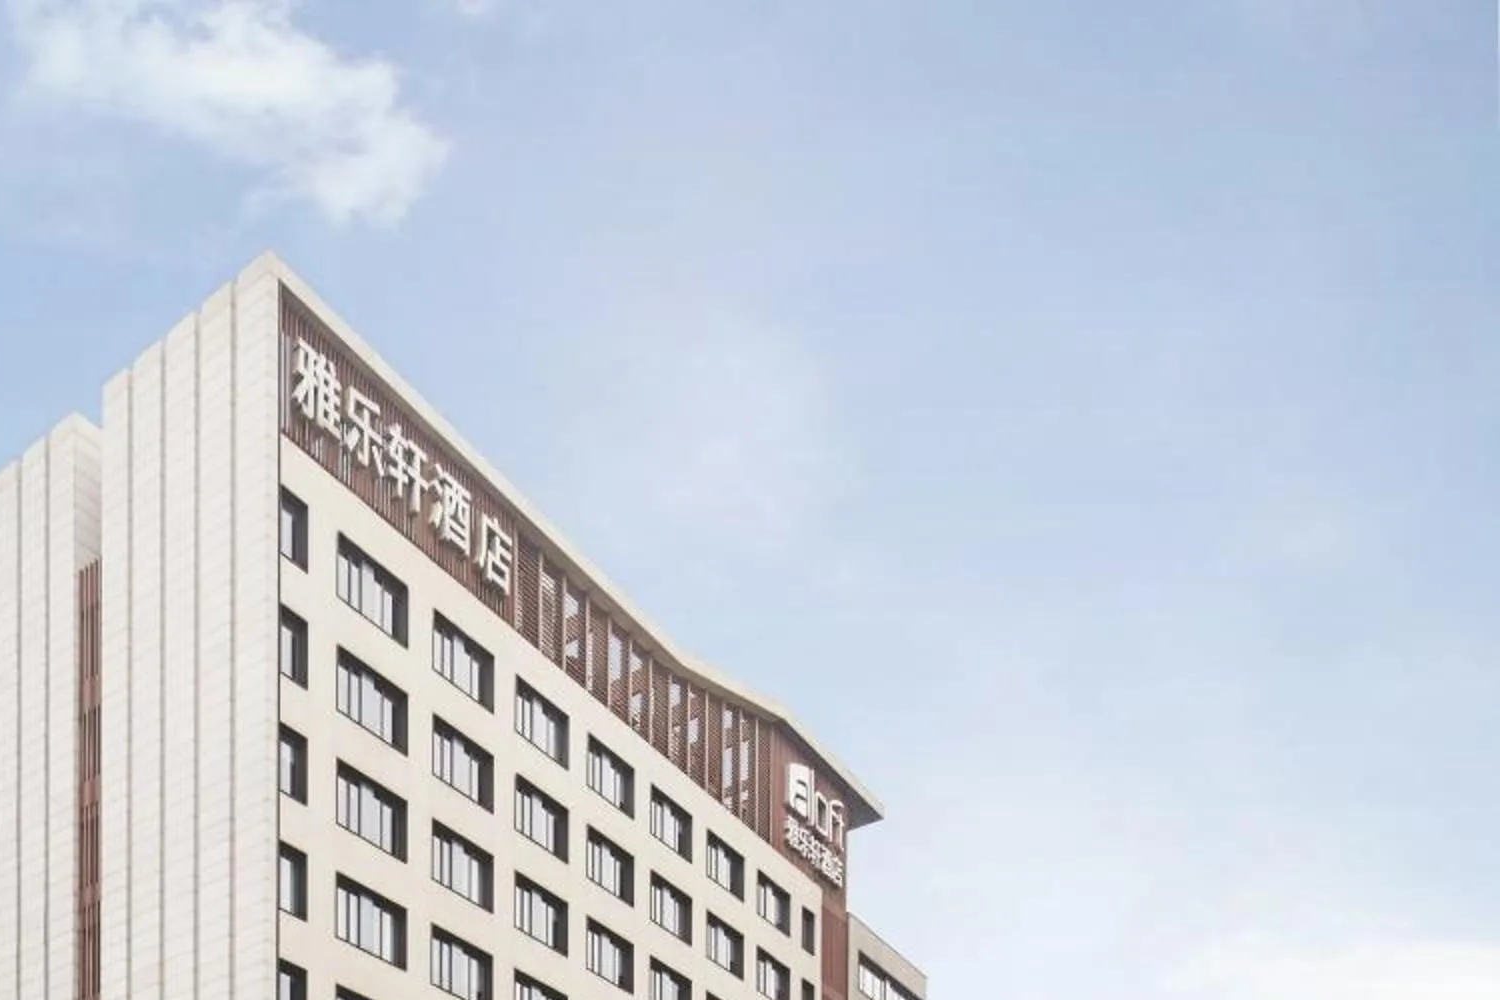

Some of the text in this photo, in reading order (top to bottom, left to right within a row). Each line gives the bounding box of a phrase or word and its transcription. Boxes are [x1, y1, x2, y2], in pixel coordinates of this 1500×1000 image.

[292, 338, 512, 596] 雅乐轩酒店
